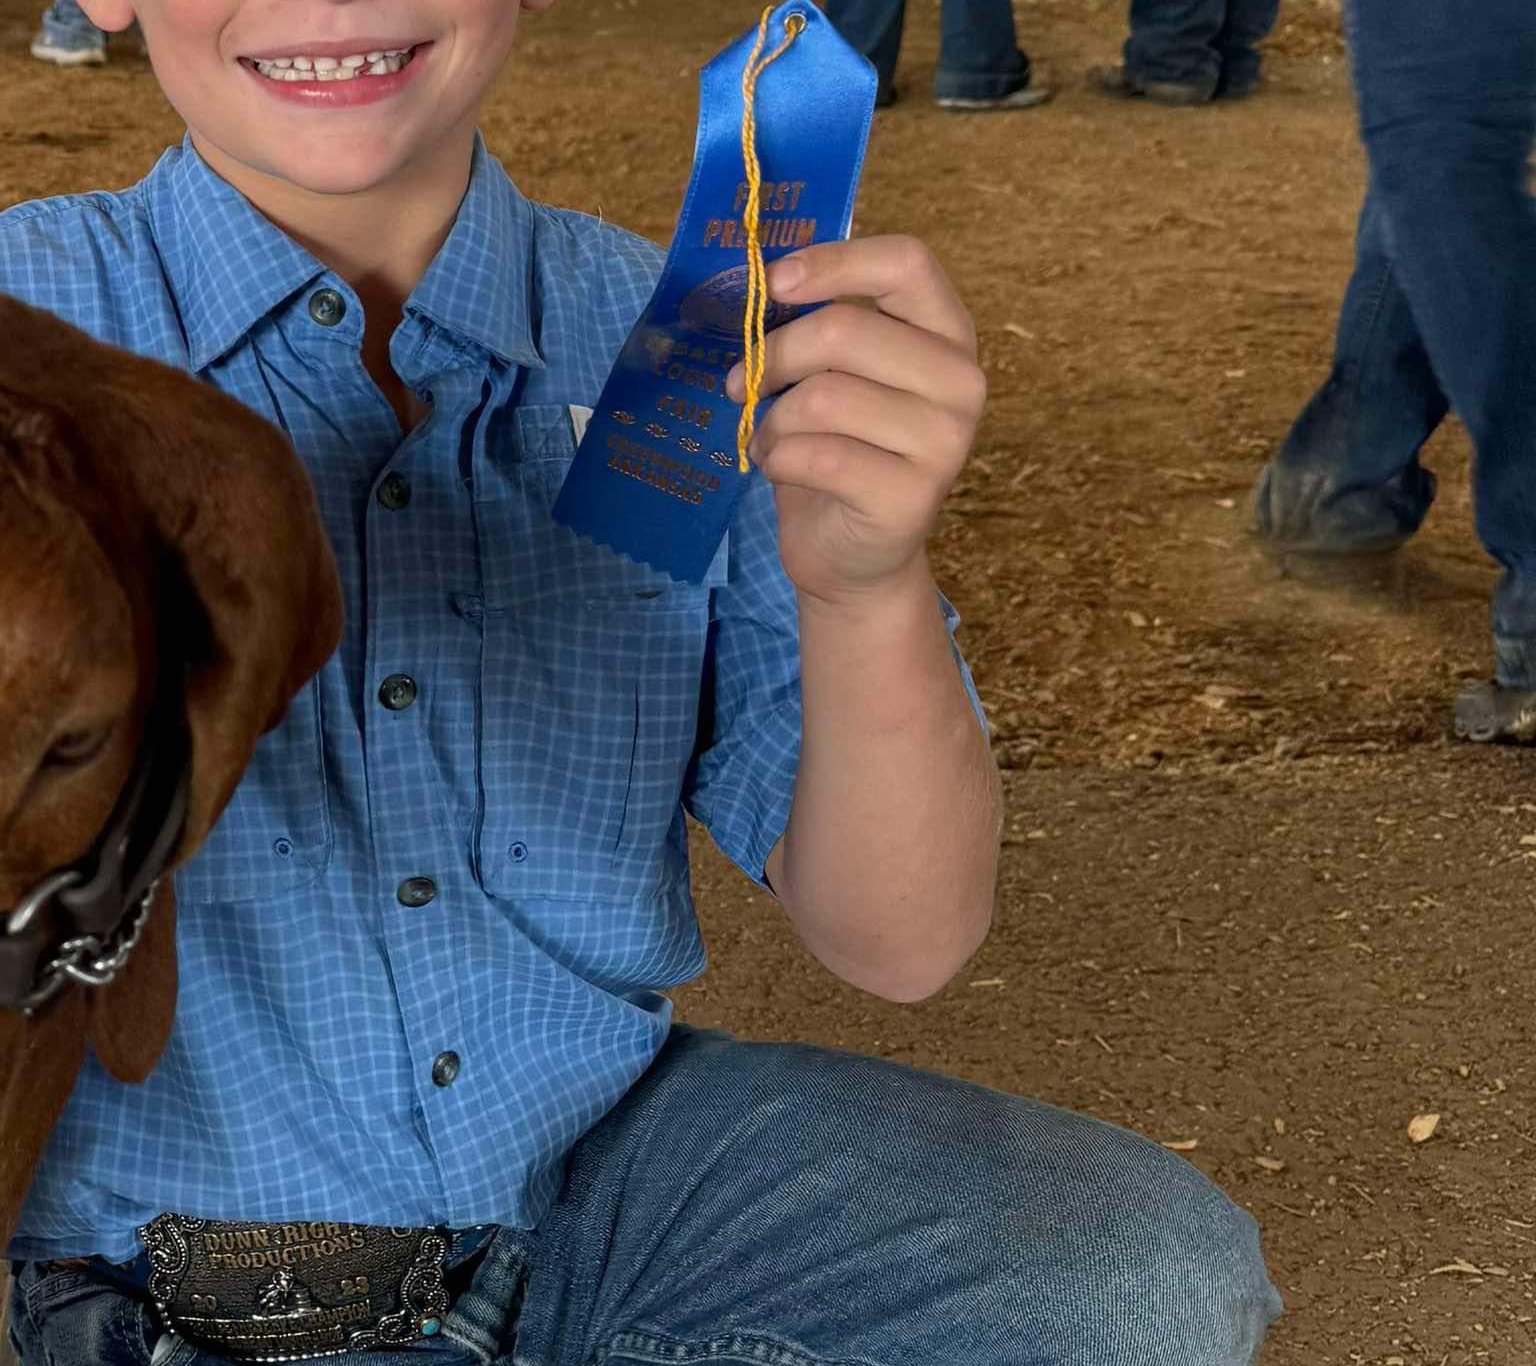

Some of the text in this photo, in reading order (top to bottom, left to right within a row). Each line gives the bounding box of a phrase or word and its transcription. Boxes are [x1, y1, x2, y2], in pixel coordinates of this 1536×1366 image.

[734, 181, 805, 211] FRST
[204, 1228, 271, 1252] DUNN
[208, 1230, 365, 1270] PRODUCTIONS
